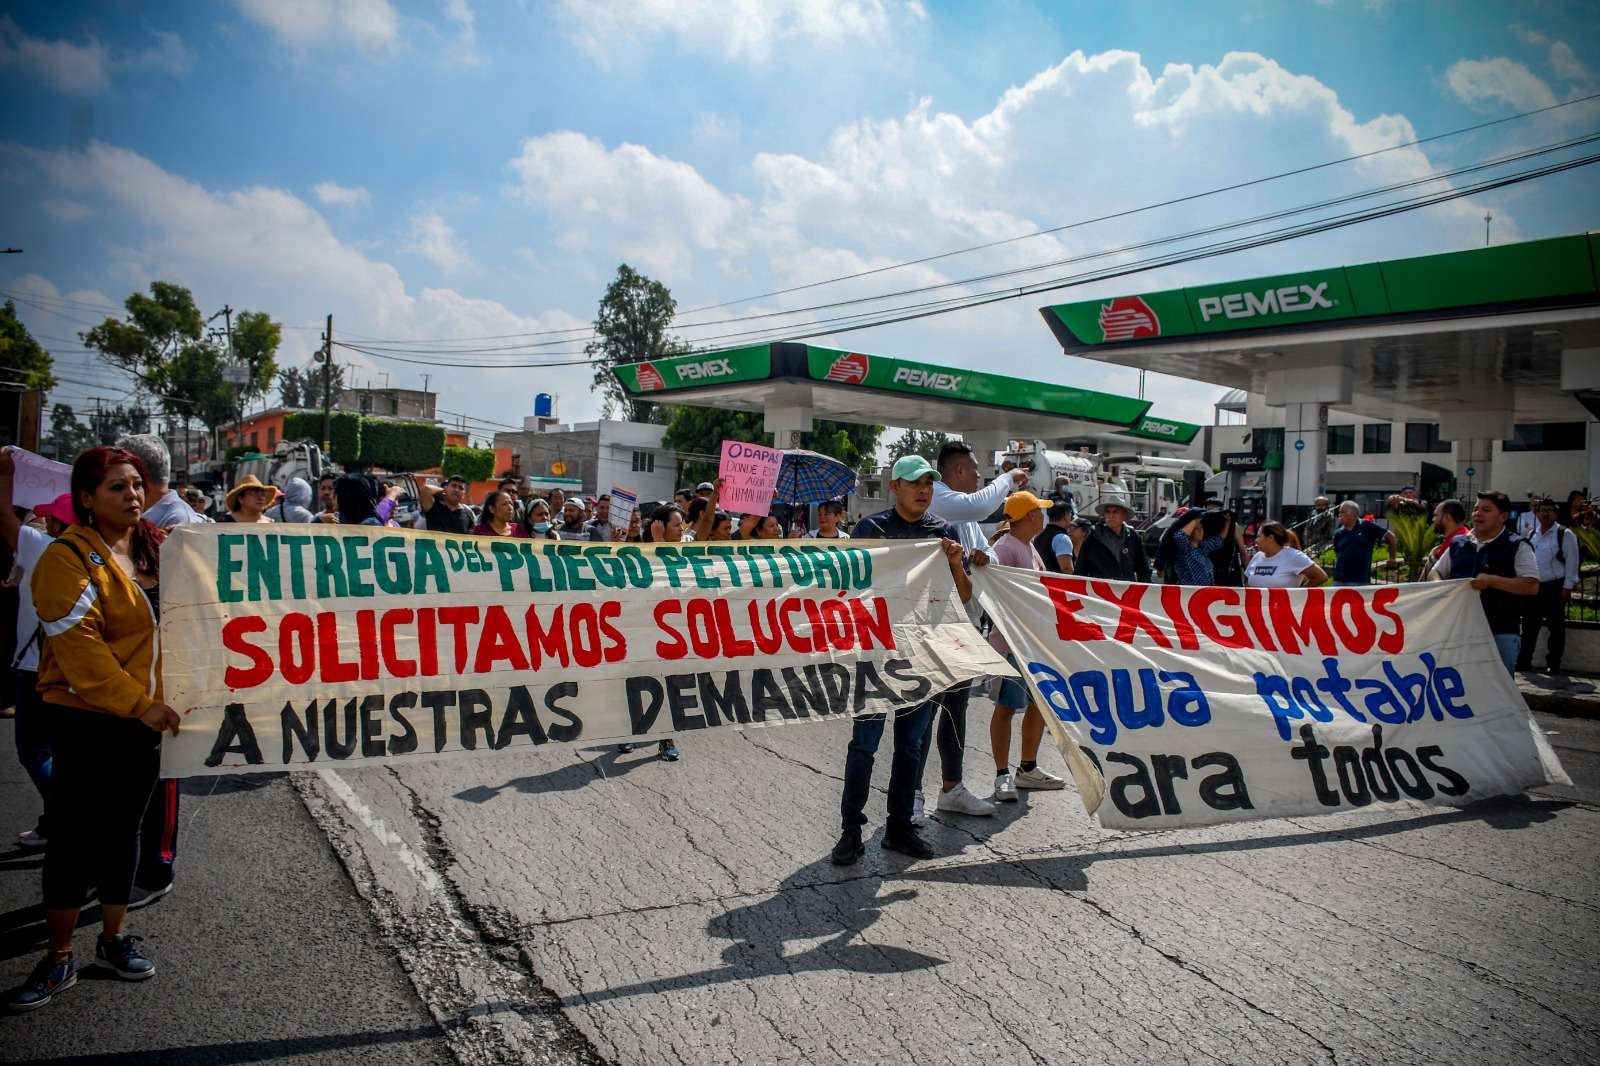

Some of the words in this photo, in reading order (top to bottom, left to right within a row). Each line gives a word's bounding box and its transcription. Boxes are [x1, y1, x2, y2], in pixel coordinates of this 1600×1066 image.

[1199, 282, 1333, 321] PEMEX
[675, 358, 733, 381] PEMEX
[893, 367, 962, 391] PEMEX
[728, 443, 780, 464] ODAPAS
[1141, 420, 1179, 435] PEMEX
[1226, 457, 1257, 465] PEMEX
[217, 535, 450, 602] ENTREGA
[446, 540, 493, 573] DEL
[491, 542, 654, 593] PLIEGO
[656, 545, 874, 590] PETITORIO
[223, 600, 627, 689] SOLICITAMOS
[653, 590, 896, 660] SOLUCIÓN
[1040, 576, 1406, 655] EXIGIMOS
[204, 703, 265, 768] A
[280, 682, 583, 764] NUESTRAS
[626, 658, 932, 736] DEMANDAS
[1028, 661, 1212, 746] agua
[1253, 652, 1474, 741] potable
[1290, 723, 1470, 807] todos
